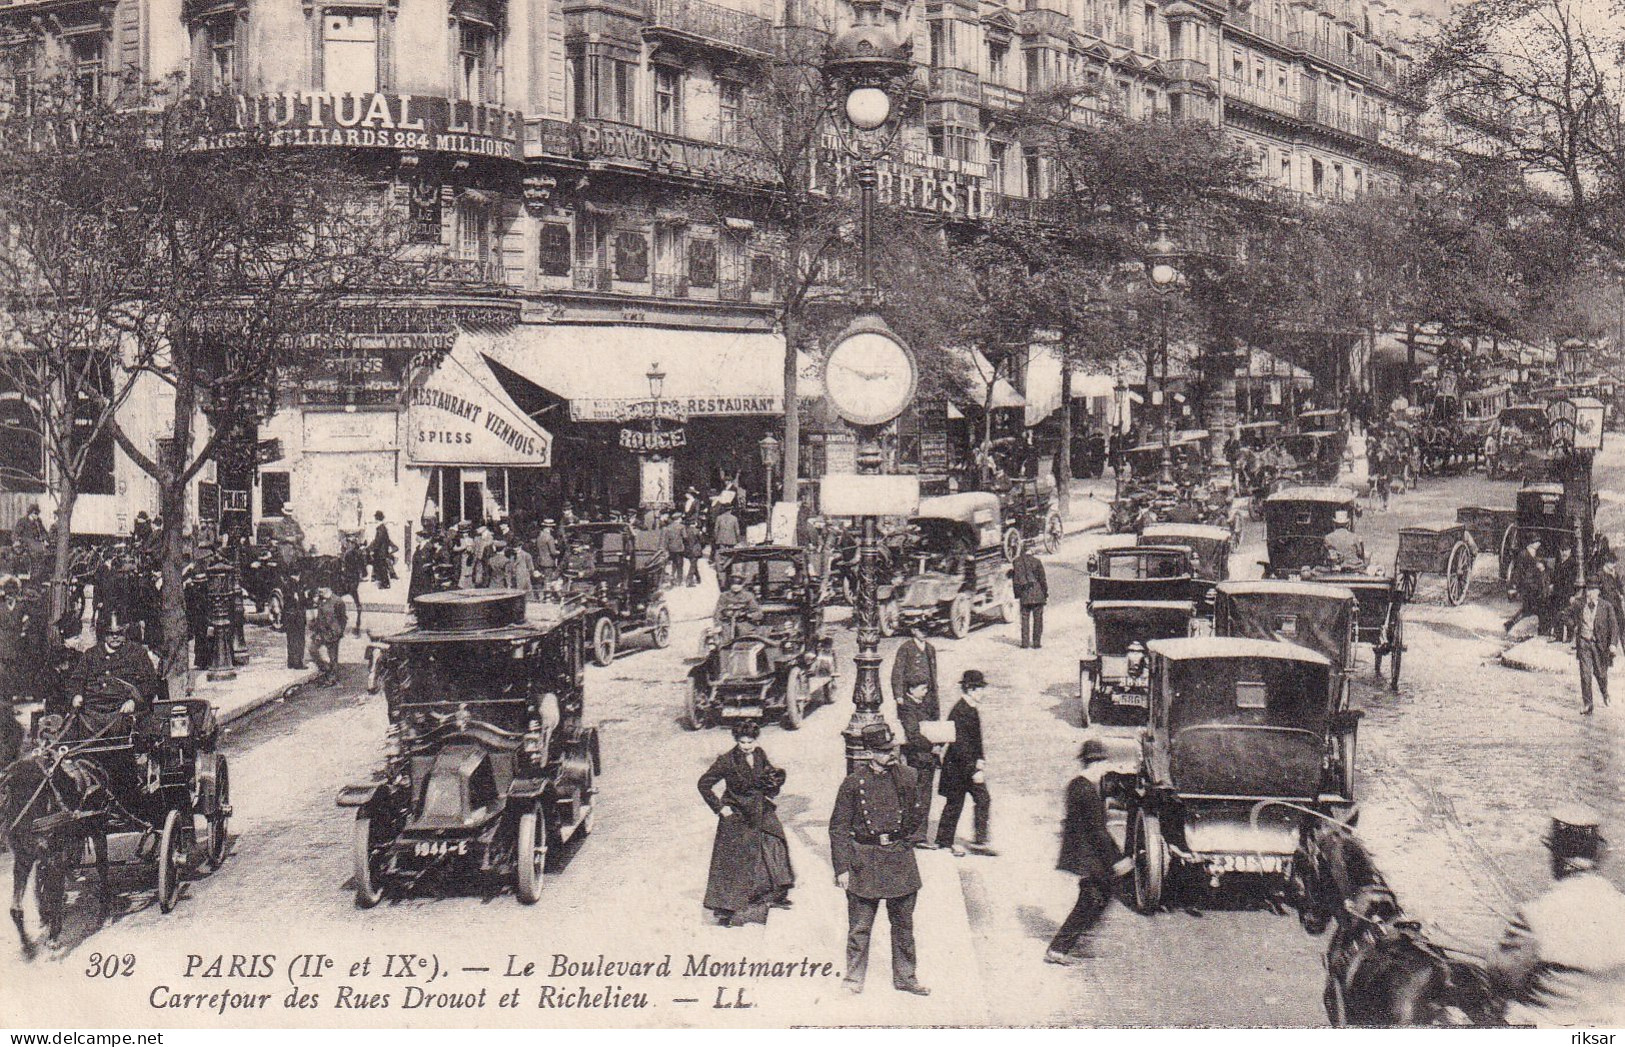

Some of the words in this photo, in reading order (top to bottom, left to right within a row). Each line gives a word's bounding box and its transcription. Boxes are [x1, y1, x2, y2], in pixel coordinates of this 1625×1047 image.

[447, 100, 518, 140] LIFE
[394, 132, 429, 150] 284
[436, 134, 511, 158] MILLIONS
[688, 398, 775, 414] RESTAURANT
[411, 387, 482, 423] RESTAURANT
[485, 411, 536, 456] VIENNOIS
[418, 431, 473, 444] SPIESS
